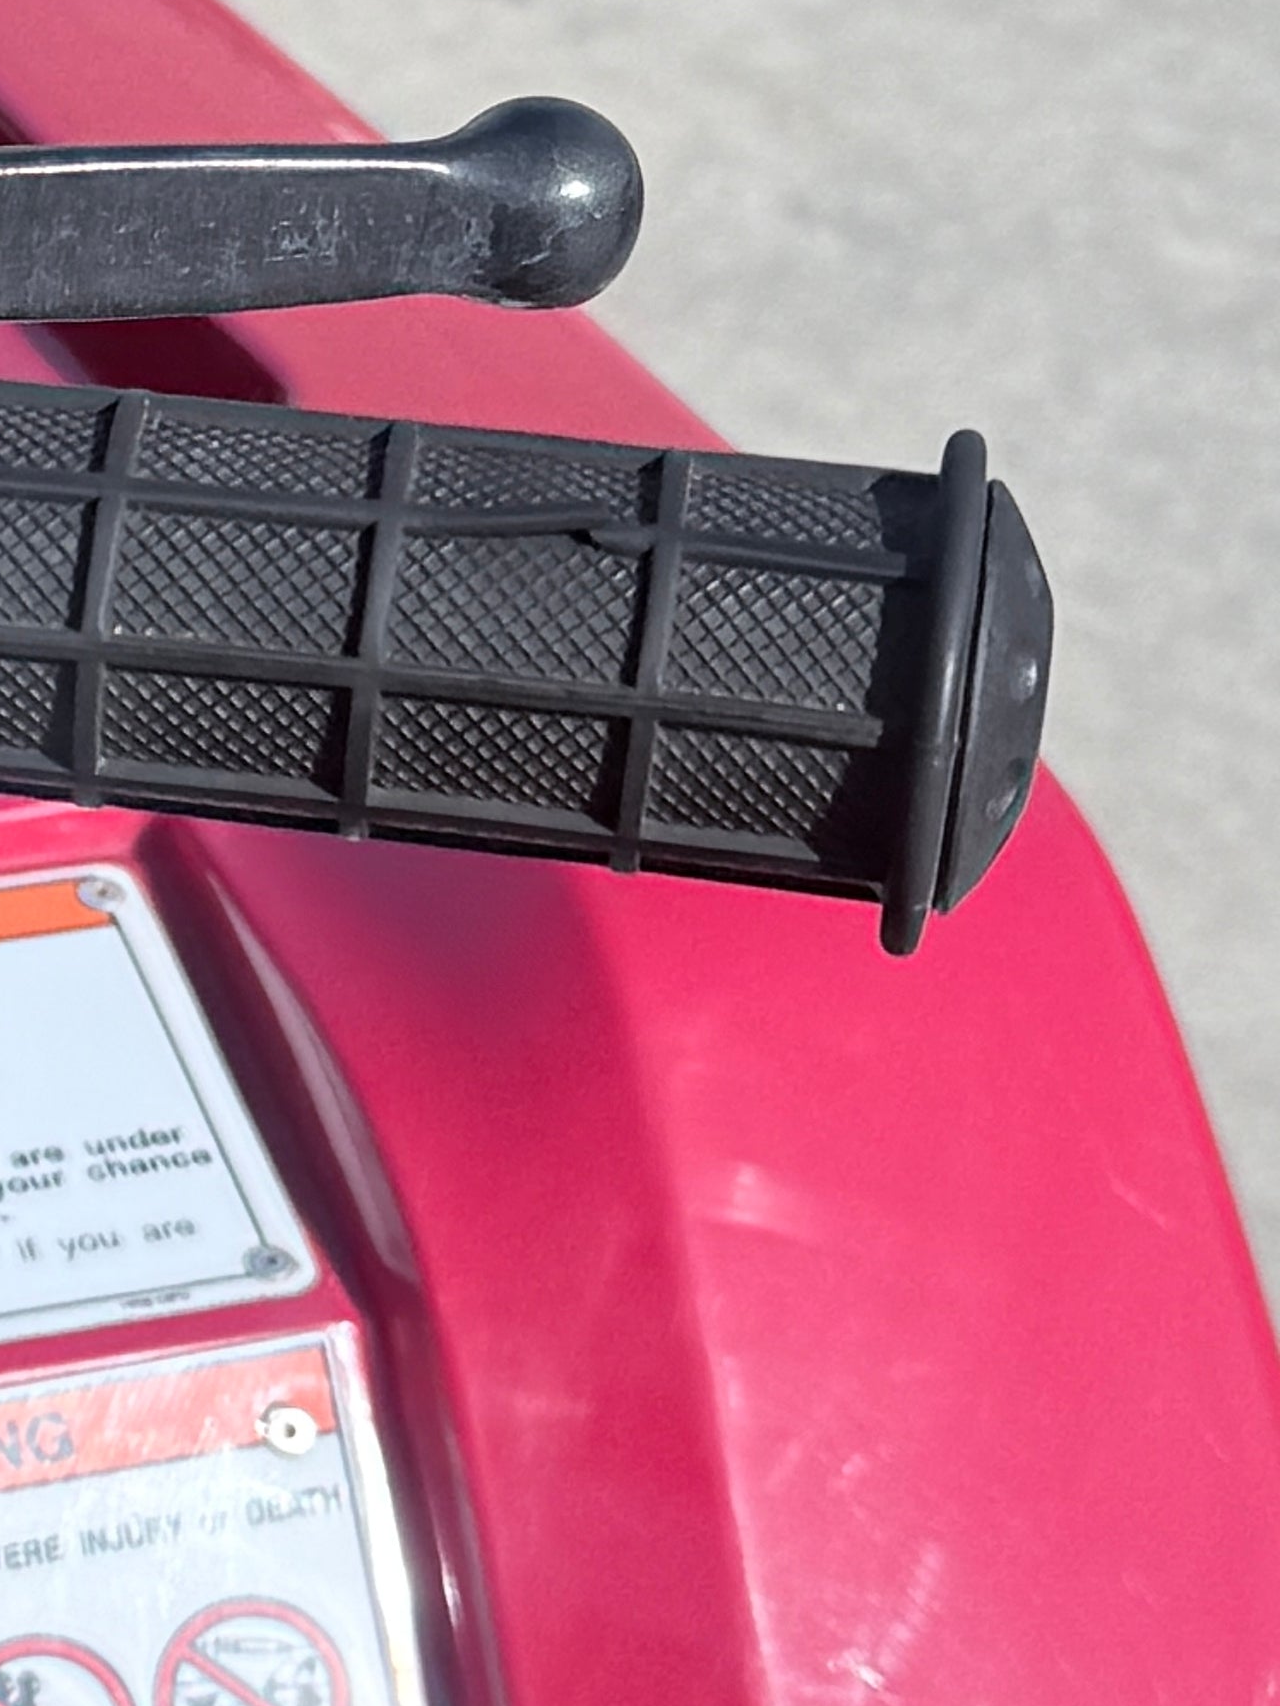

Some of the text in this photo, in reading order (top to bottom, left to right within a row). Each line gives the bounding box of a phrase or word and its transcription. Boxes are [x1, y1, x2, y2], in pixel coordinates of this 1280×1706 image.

[7, 1144, 67, 1169] are
[80, 1123, 187, 1158] under
[82, 1146, 214, 1183] chance
[14, 1237, 40, 1261] if
[55, 1227, 124, 1261] you
[137, 1216, 199, 1243] are
